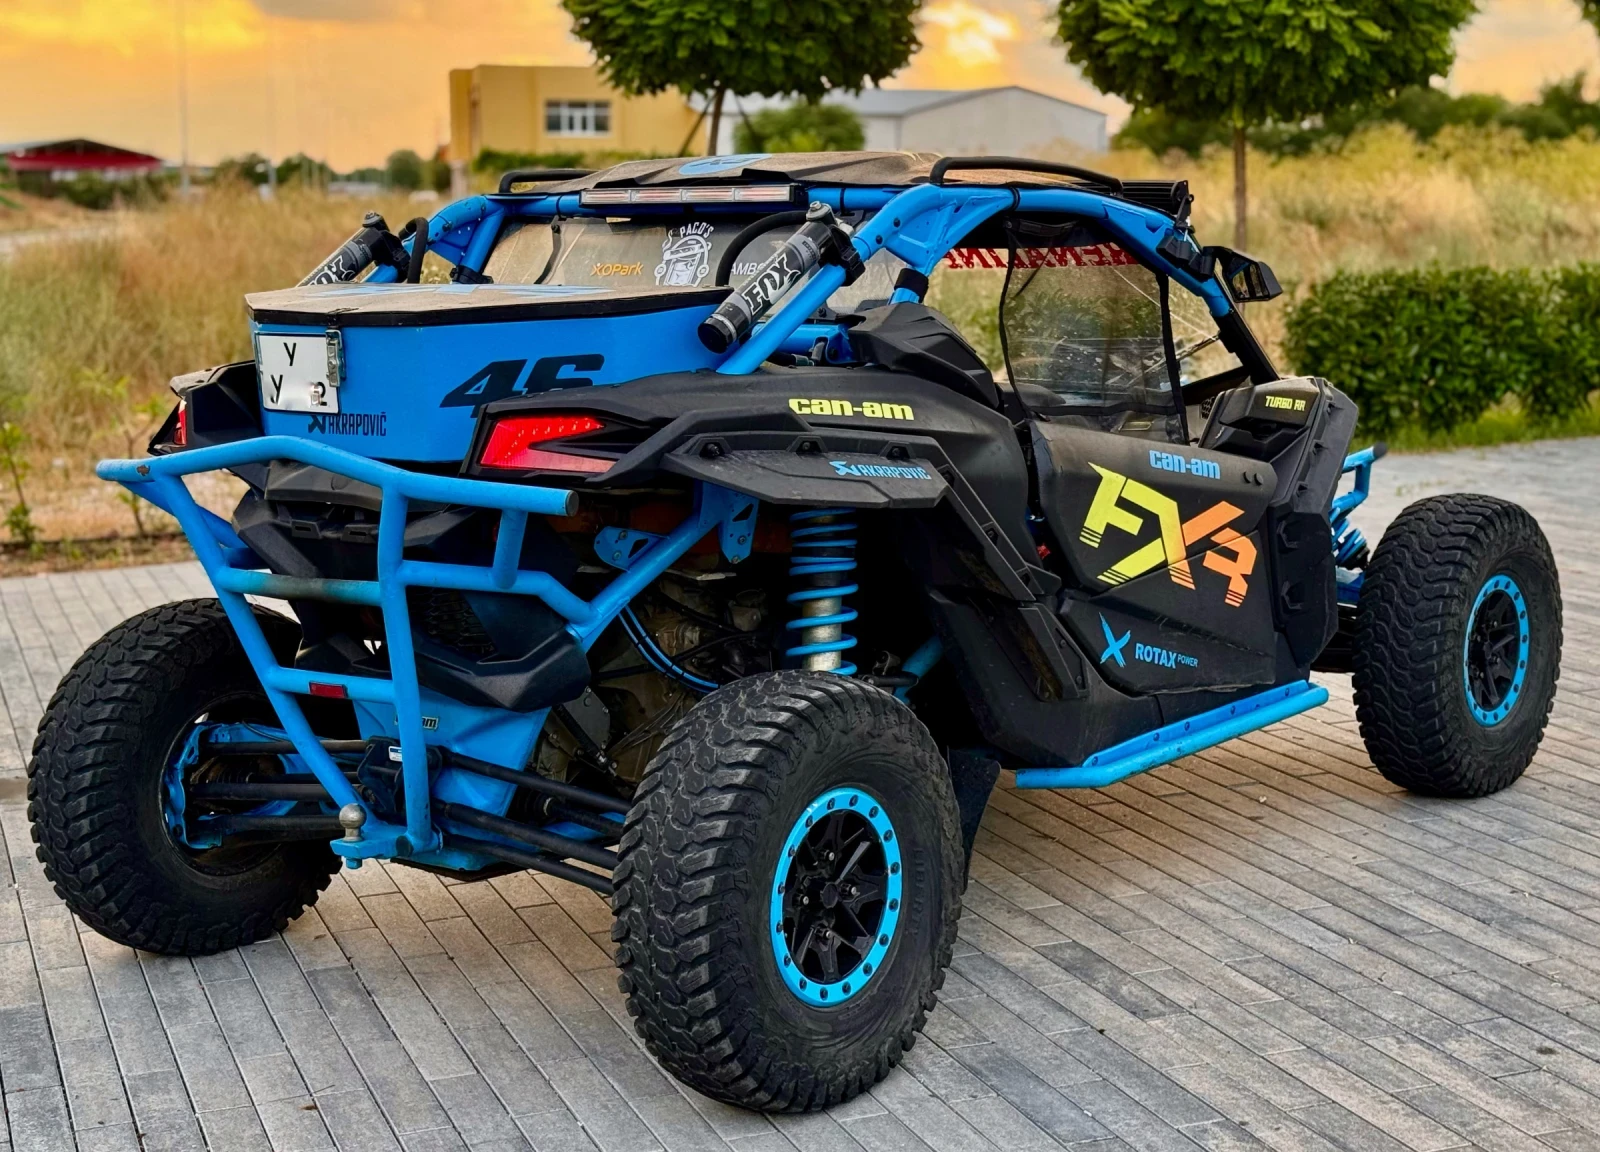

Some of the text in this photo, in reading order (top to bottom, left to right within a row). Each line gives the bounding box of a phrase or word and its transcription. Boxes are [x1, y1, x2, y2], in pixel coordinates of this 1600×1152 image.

[679, 221, 715, 239] PACO'S
[741, 252, 801, 316] FOX
[439, 353, 605, 418] 46
[788, 398, 915, 421] can-am
[1265, 395, 1306, 411] TURBO RR
[1149, 449, 1221, 480] can-am
[1134, 642, 1199, 669] ROTAX POWER
